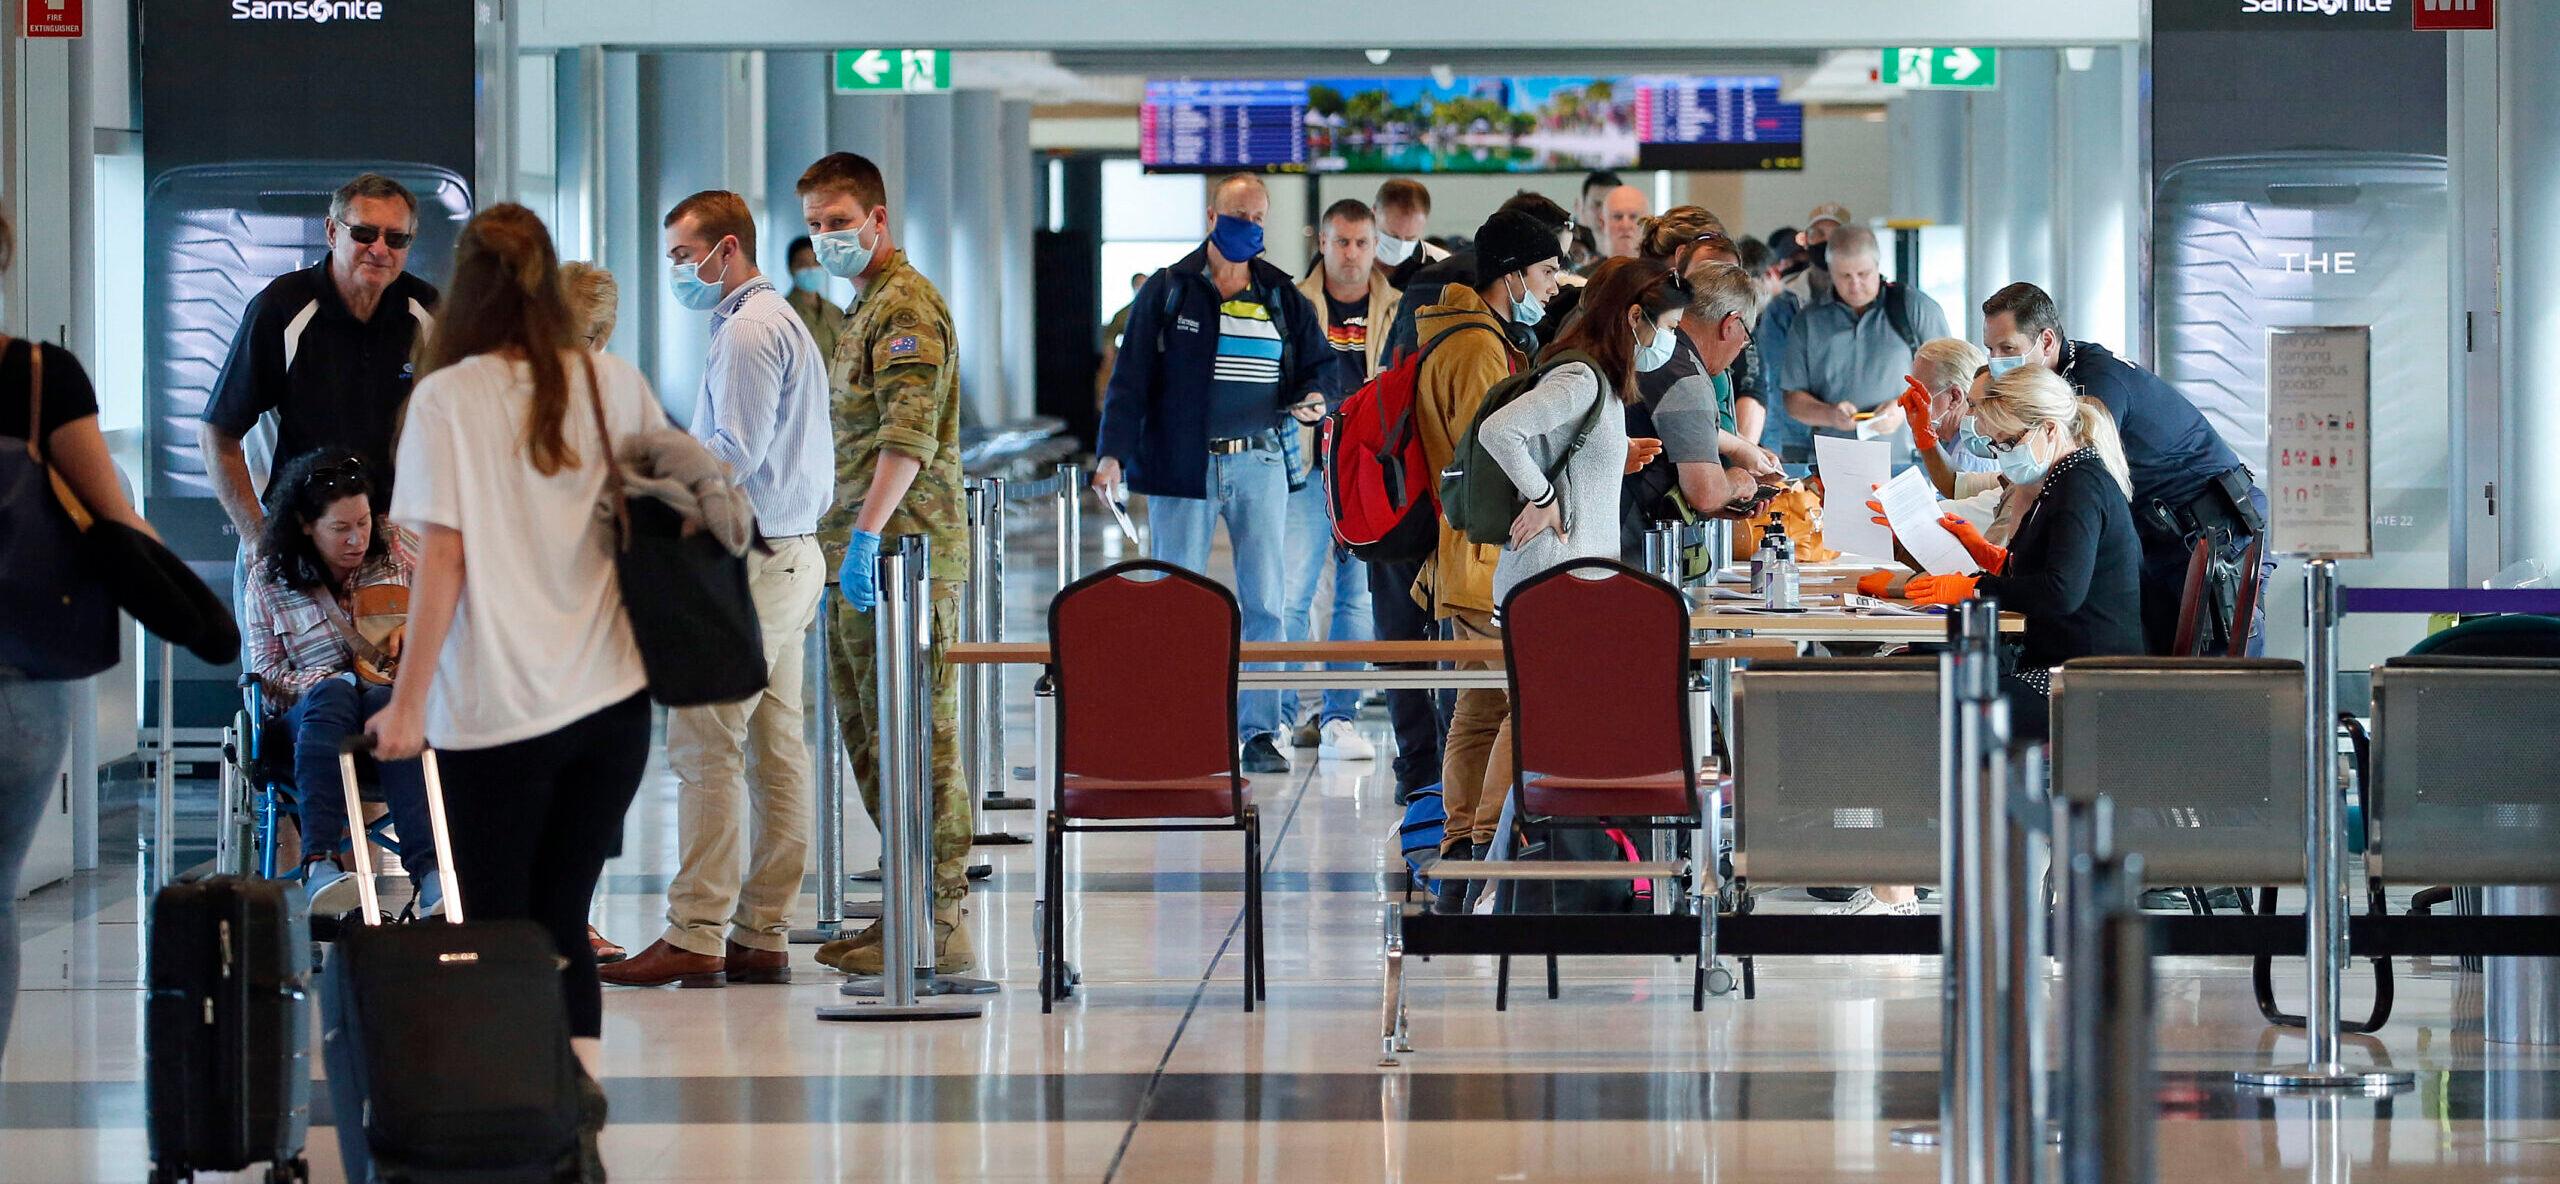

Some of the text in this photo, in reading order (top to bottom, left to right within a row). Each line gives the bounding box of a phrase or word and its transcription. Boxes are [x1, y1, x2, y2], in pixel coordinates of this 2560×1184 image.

[232, 0, 383, 23] Samsonite
[29, 24, 80, 32] EXTINGUISHER
[2278, 252, 2356, 274] THE
[2375, 515, 2414, 526] ATE 22
